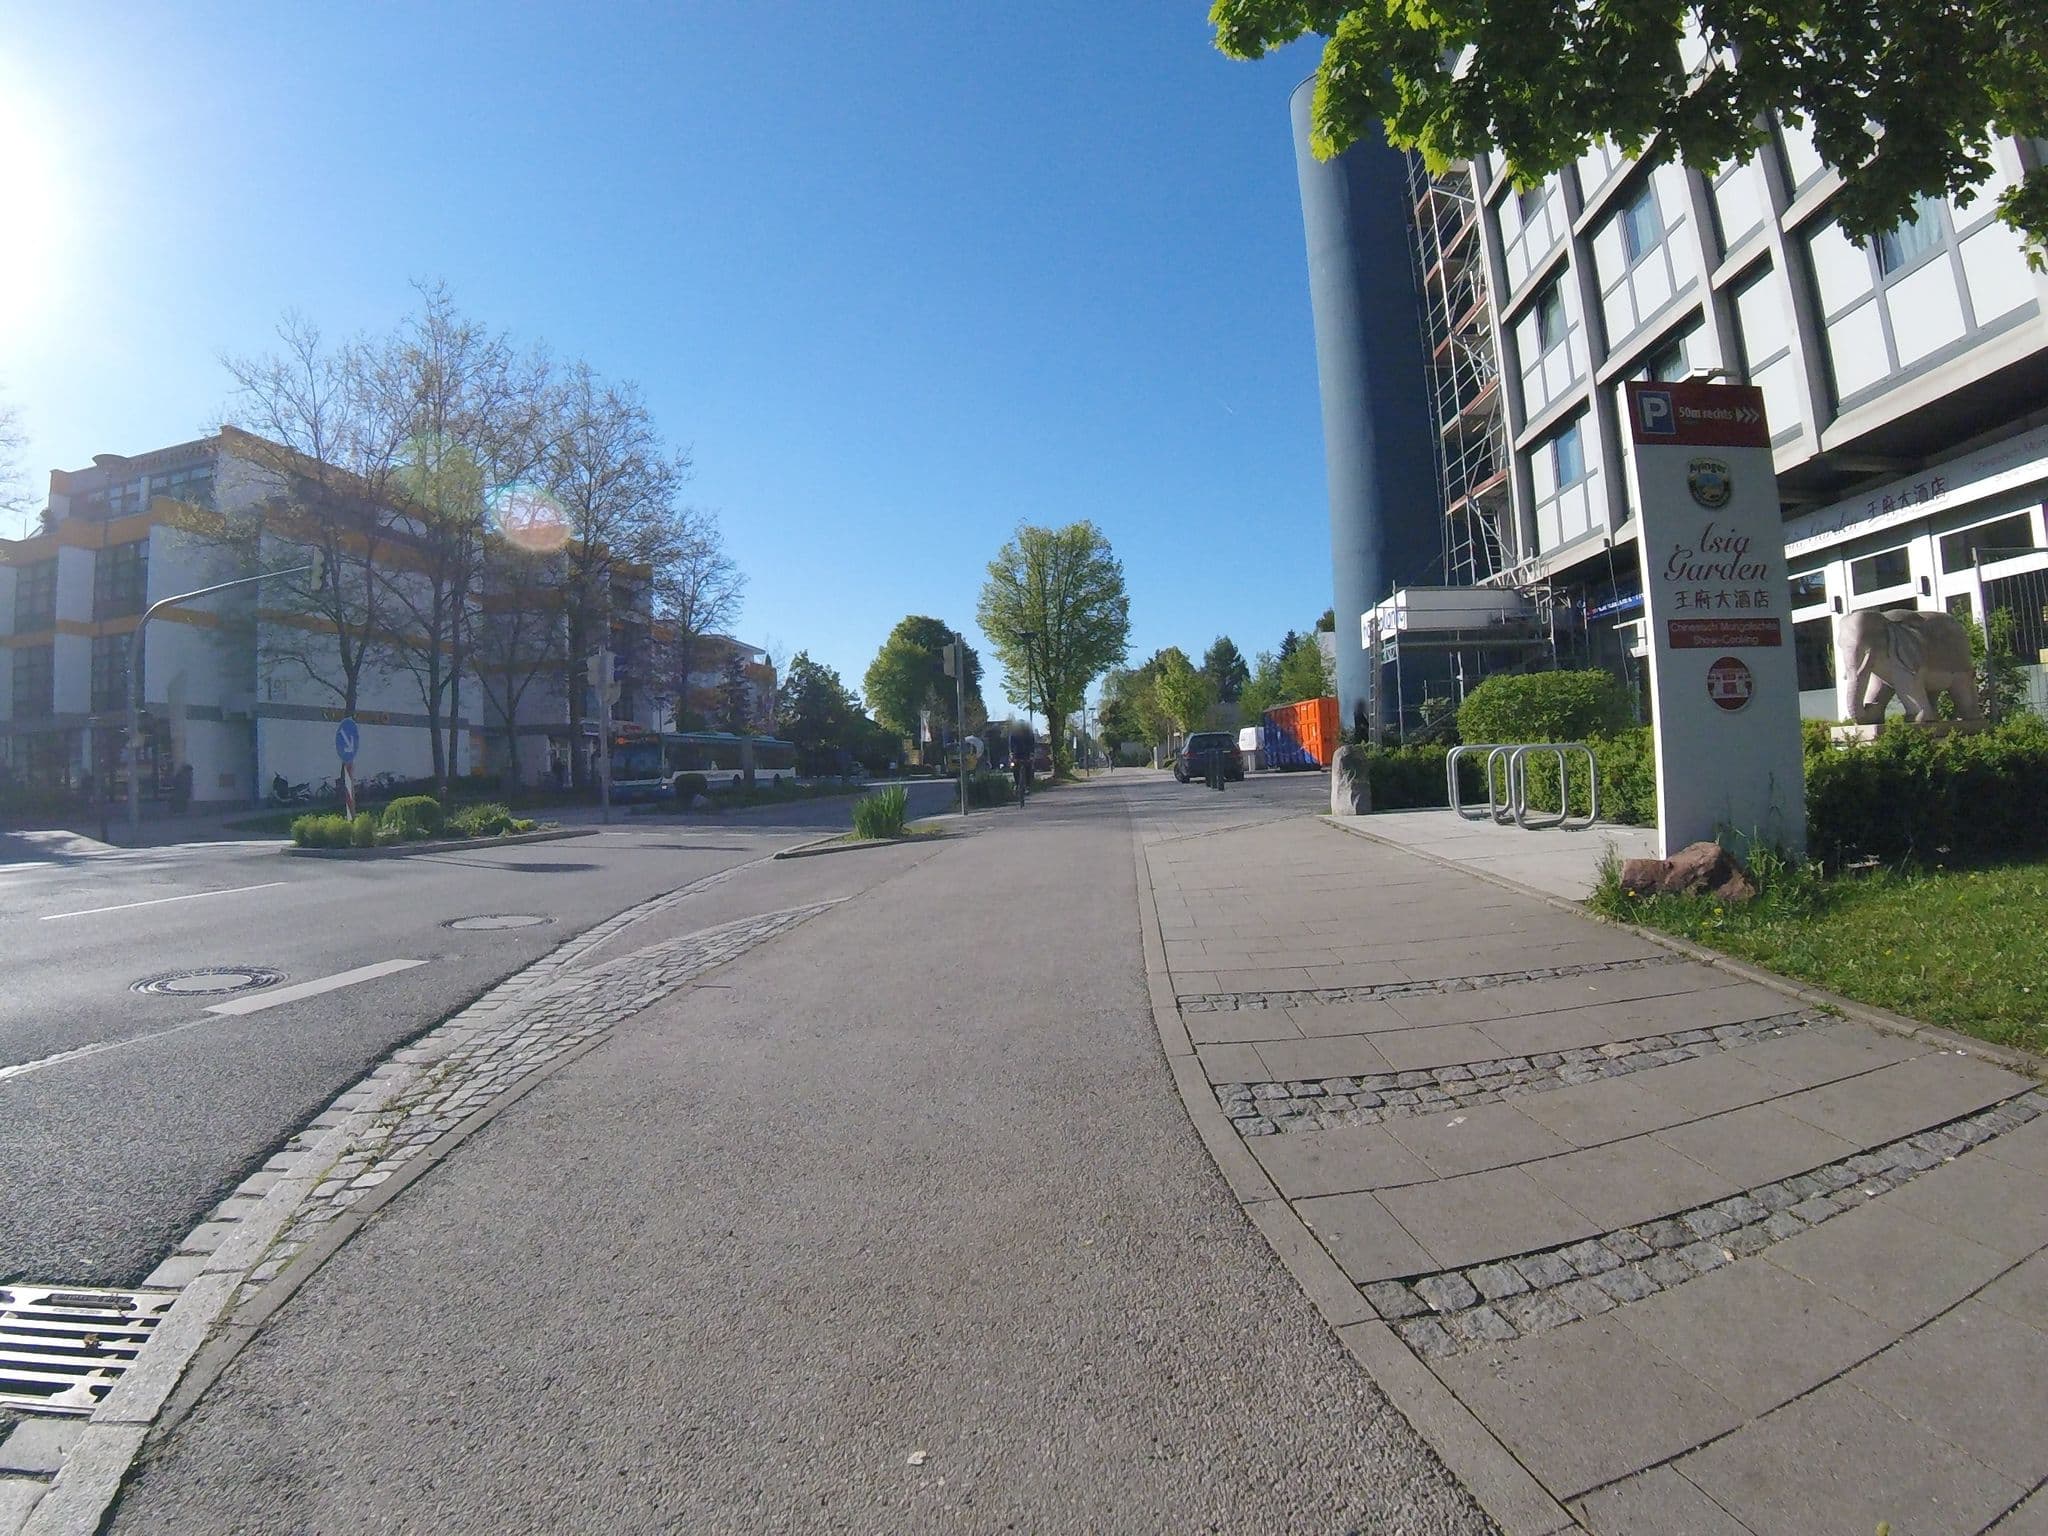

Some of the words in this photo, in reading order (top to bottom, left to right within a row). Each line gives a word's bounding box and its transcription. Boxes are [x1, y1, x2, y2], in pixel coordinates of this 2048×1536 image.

[1642, 397, 1669, 428] P
[1678, 405, 1702, 420] 50m
[1703, 407, 1734, 421] rechts
[1664, 548, 1768, 582] Garden
[1675, 589, 1771, 610] 王府大酒店
